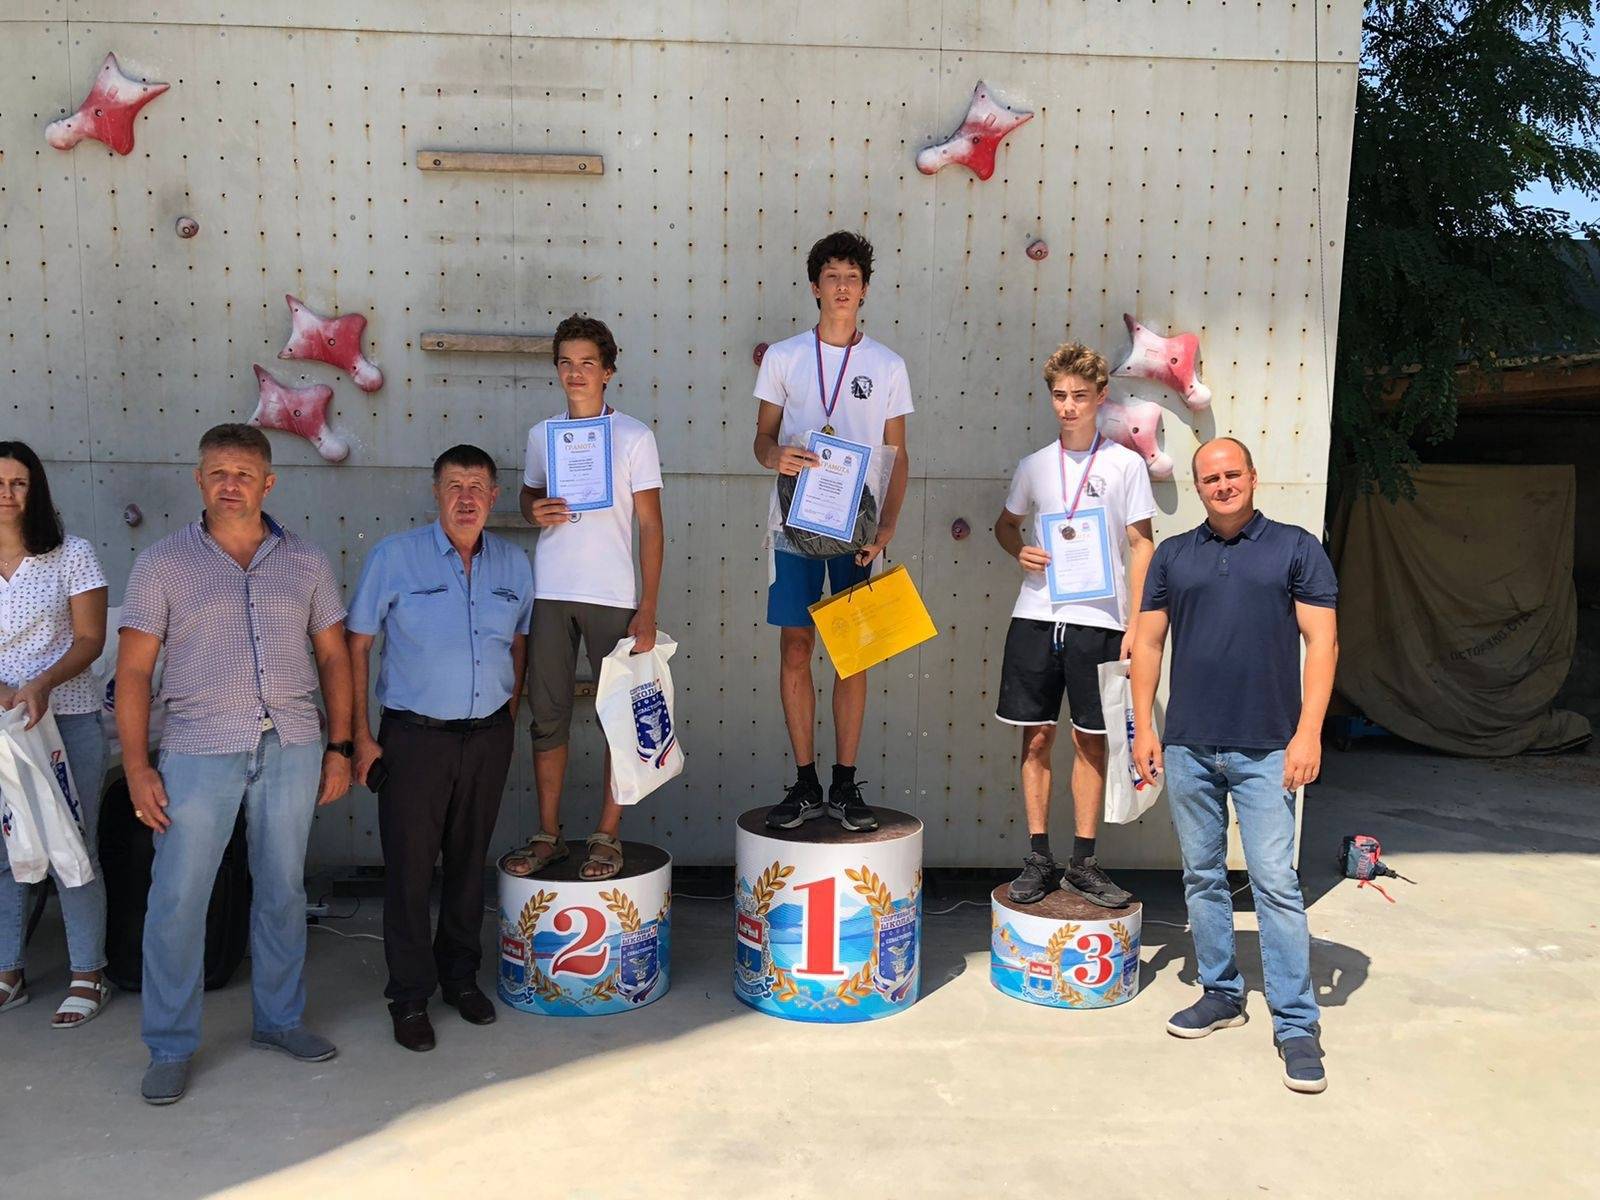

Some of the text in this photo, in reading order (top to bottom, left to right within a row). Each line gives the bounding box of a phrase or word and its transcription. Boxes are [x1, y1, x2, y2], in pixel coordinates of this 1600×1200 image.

[565, 442, 597, 451] ГРАМОТА
[552, 906, 608, 976] 2
[792, 876, 845, 976] 1
[1074, 933, 1114, 985] 3
